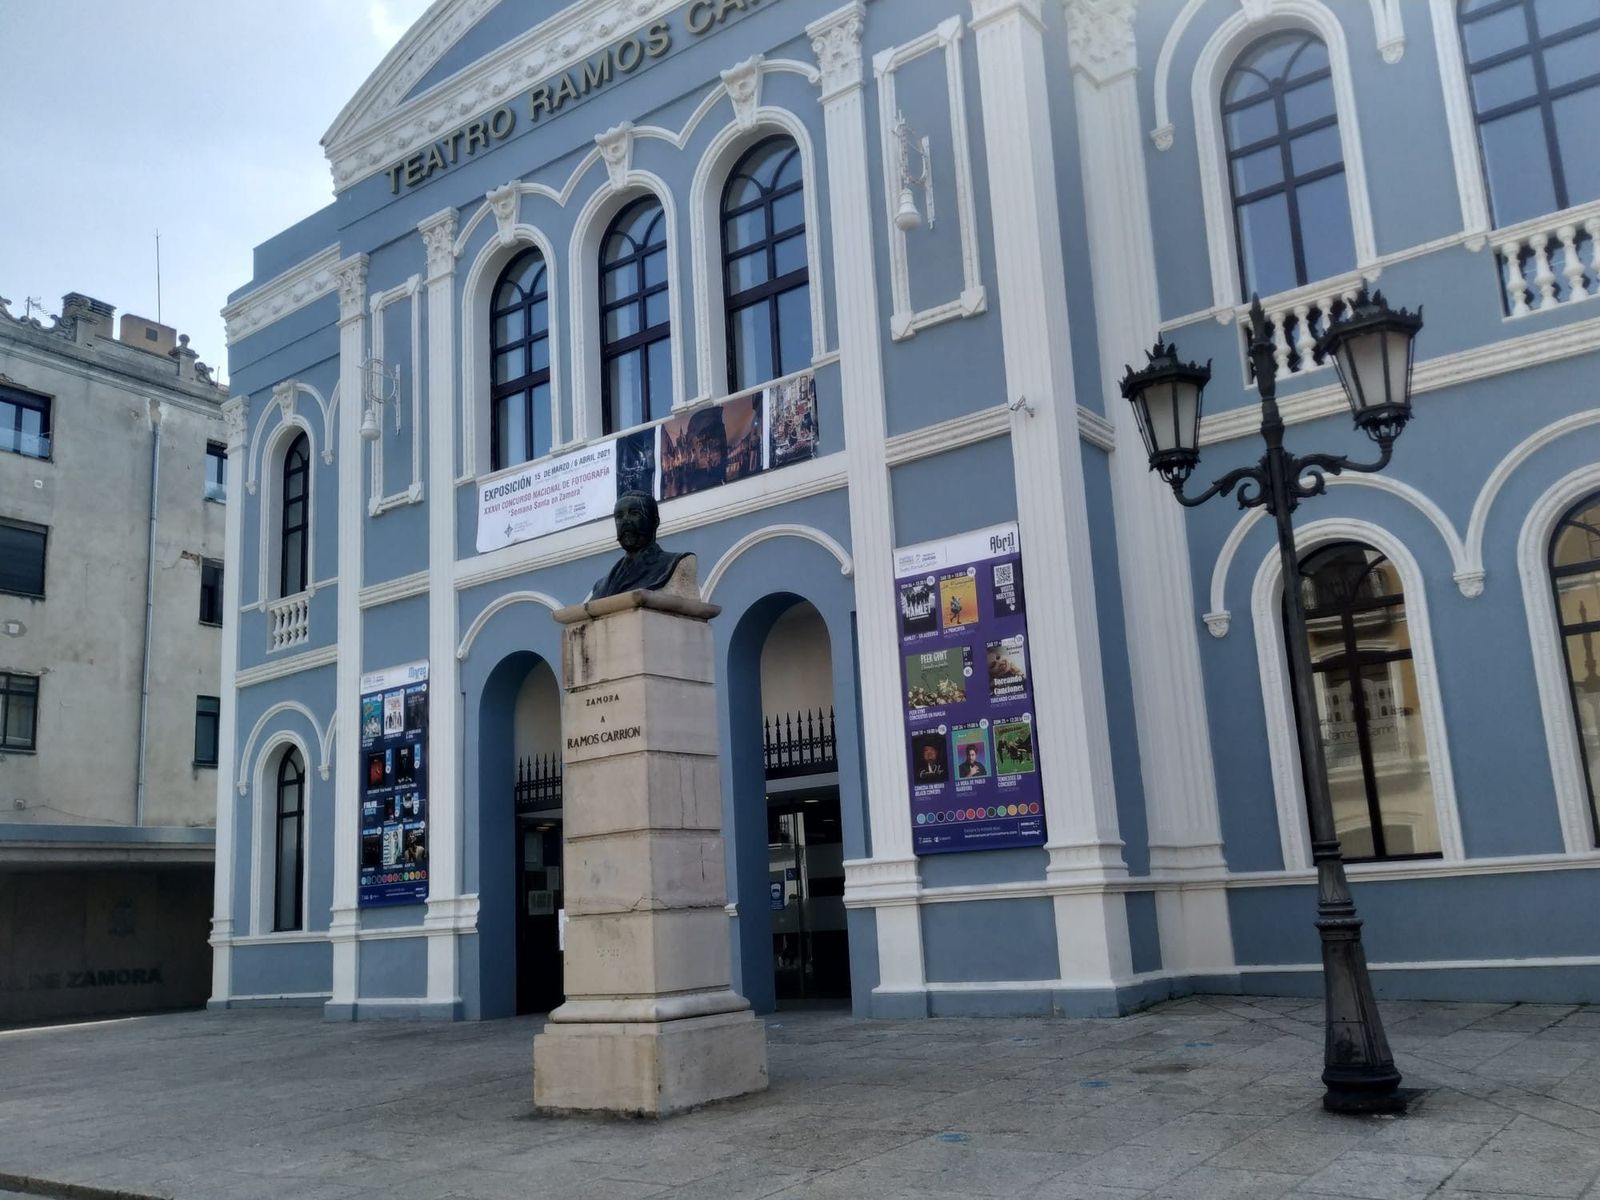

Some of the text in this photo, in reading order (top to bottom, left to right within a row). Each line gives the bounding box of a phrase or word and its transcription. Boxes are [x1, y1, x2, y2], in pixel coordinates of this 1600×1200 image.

[385, 105, 515, 194] TEATRO
[528, 20, 673, 121] RAMOS
[484, 475, 532, 502] EXPOSICIÓN
[543, 469, 551, 478] DE
[551, 462, 570, 475] MARZO
[574, 459, 578, 467] 6
[579, 454, 596, 465] ABRIL
[597, 448, 611, 459] 2021
[484, 466, 610, 515] XXXVI CONCURSO NACIONAL DE FOTOGRAFÍA
[533, 498, 550, 510] Santa
[989, 531, 1015, 554] Abril
[905, 602, 931, 619] HAMLET
[993, 674, 1023, 686] Toreando
[993, 684, 1024, 696] Canciones
[586, 693, 620, 707] ZAMORA
[567, 725, 641, 750] RAMOS CARRION
[66, 967, 163, 989] ZAMORA
